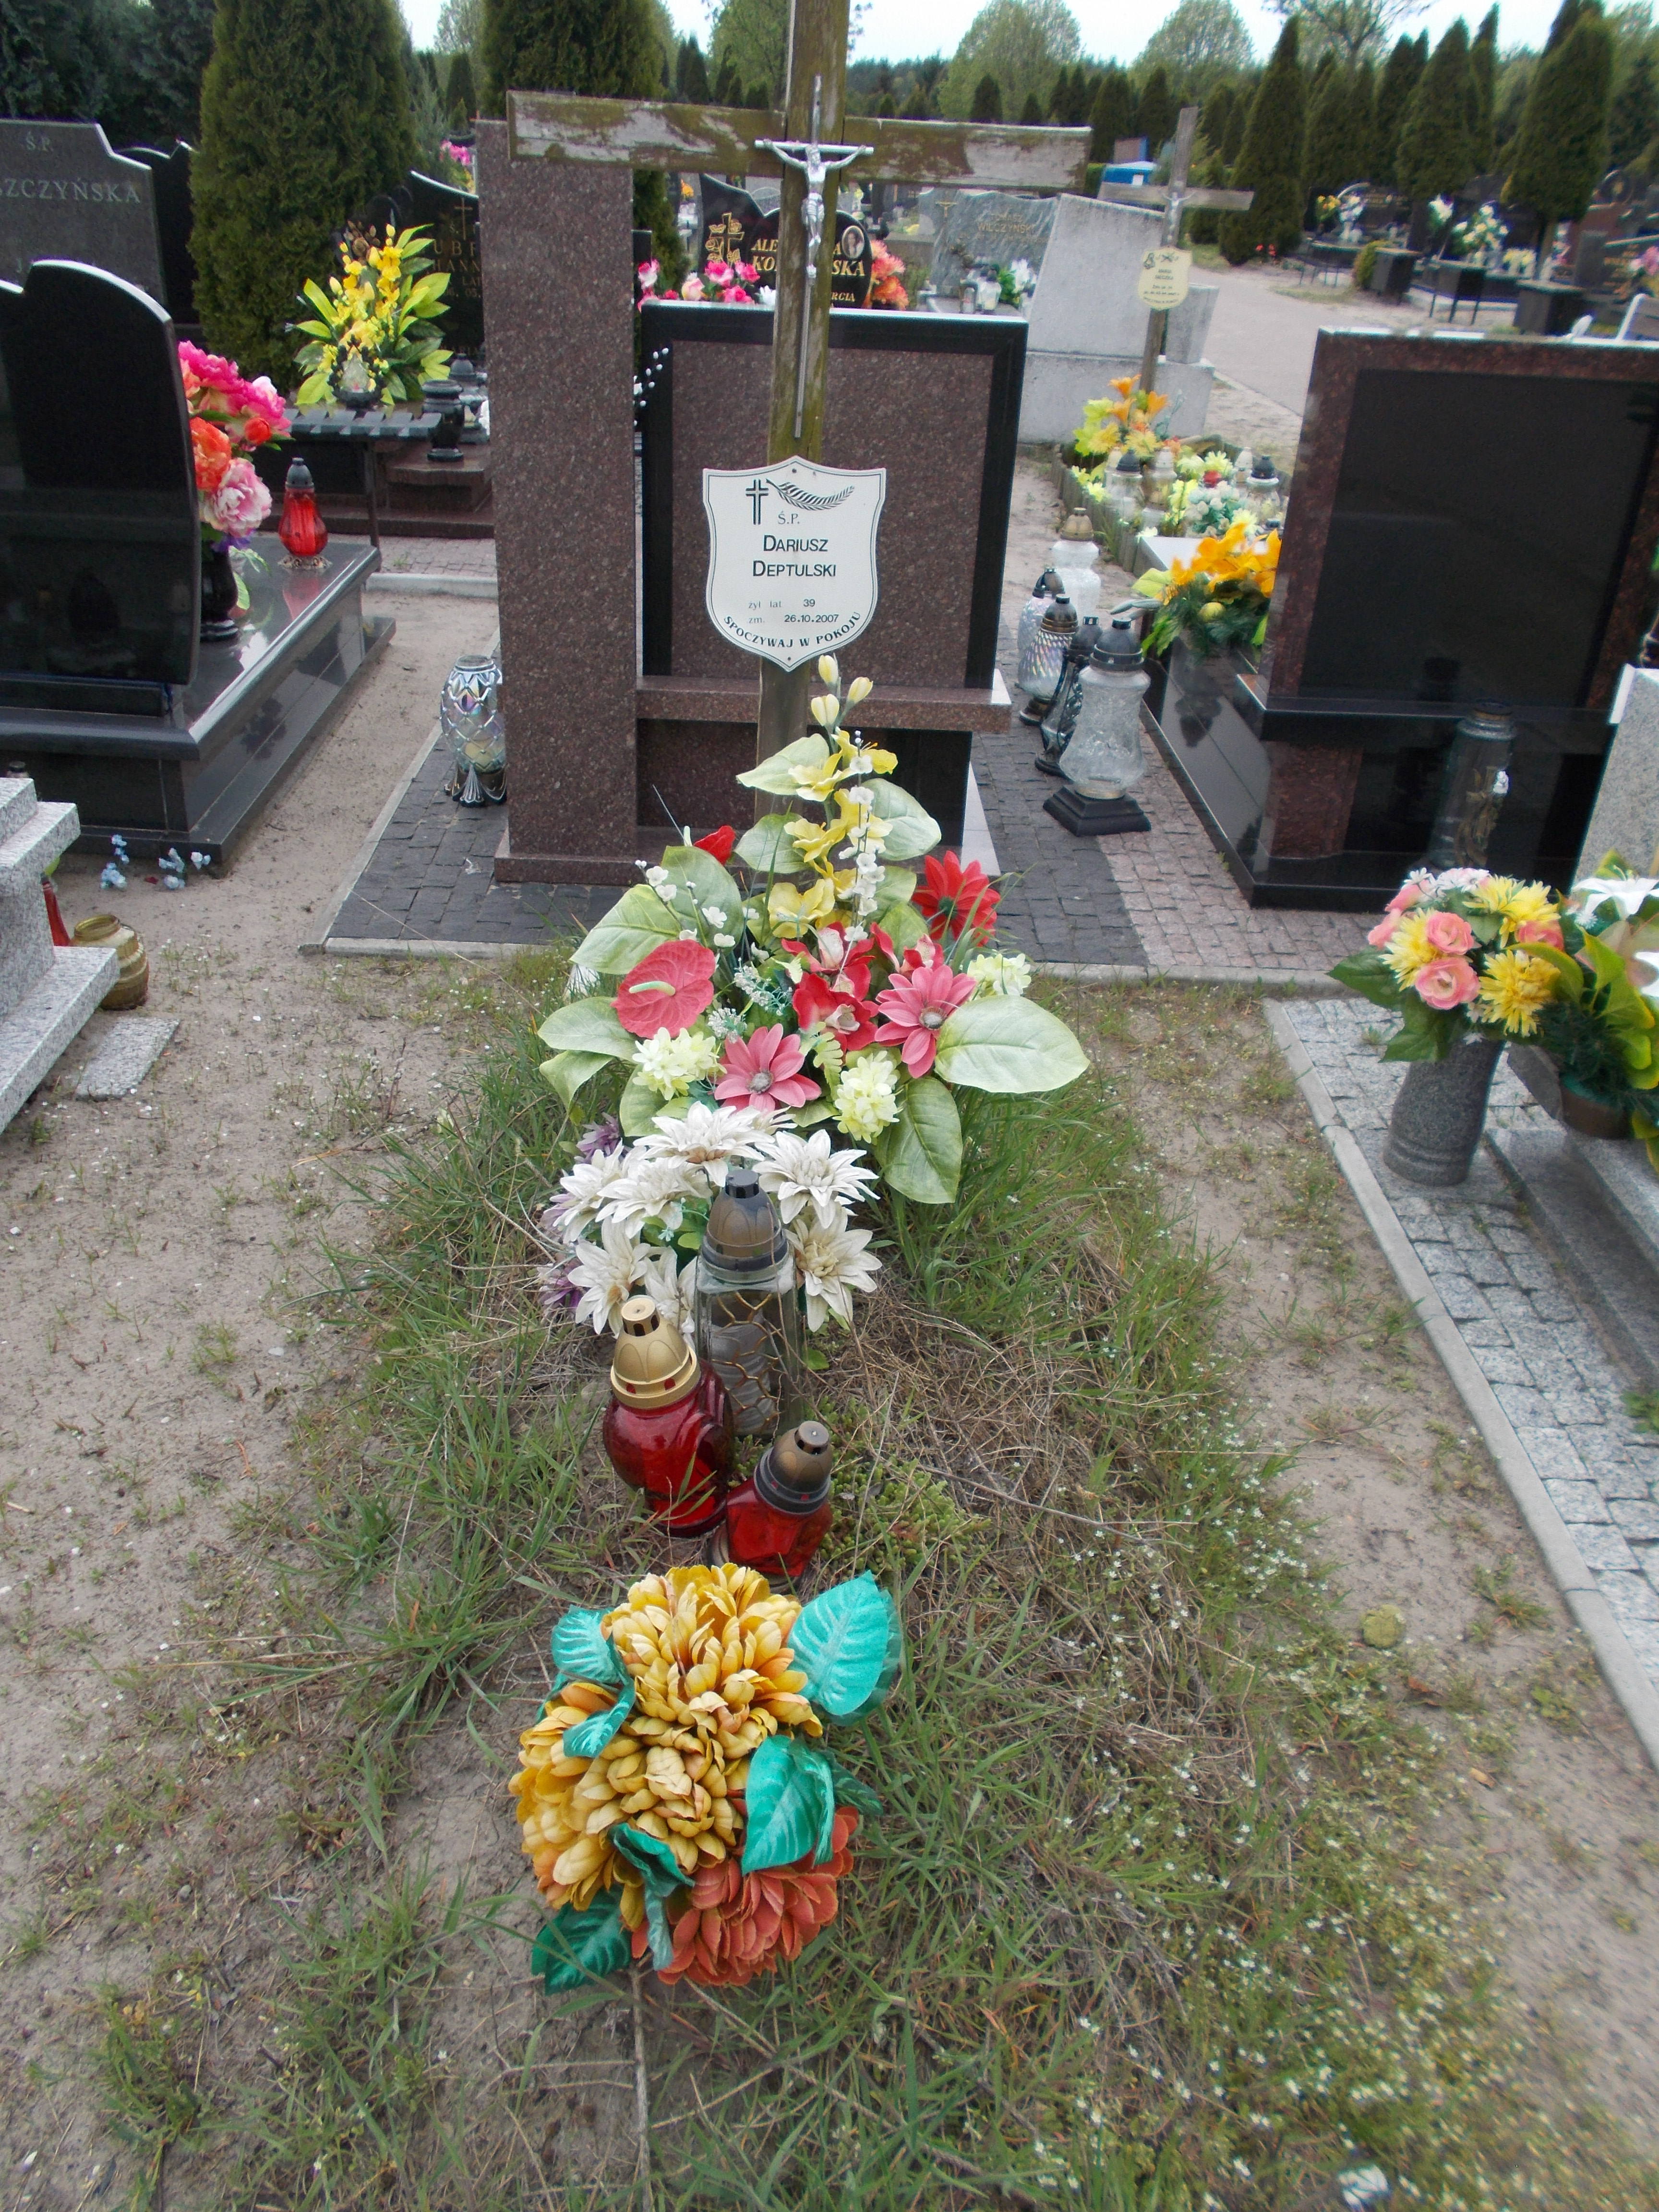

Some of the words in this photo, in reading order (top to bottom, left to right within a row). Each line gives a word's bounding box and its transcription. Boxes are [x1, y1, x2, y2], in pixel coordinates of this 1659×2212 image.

[0, 177, 141, 204] ZCZYŃSKA
[778, 510, 800, 525] Ś.P.
[804, 599, 816, 607] 39
[784, 614, 839, 623] 26.10.2007
[724, 616, 793, 648] SPOCZYWAJ
[800, 638, 810, 647] W
[816, 612, 861, 645] POKOJU
